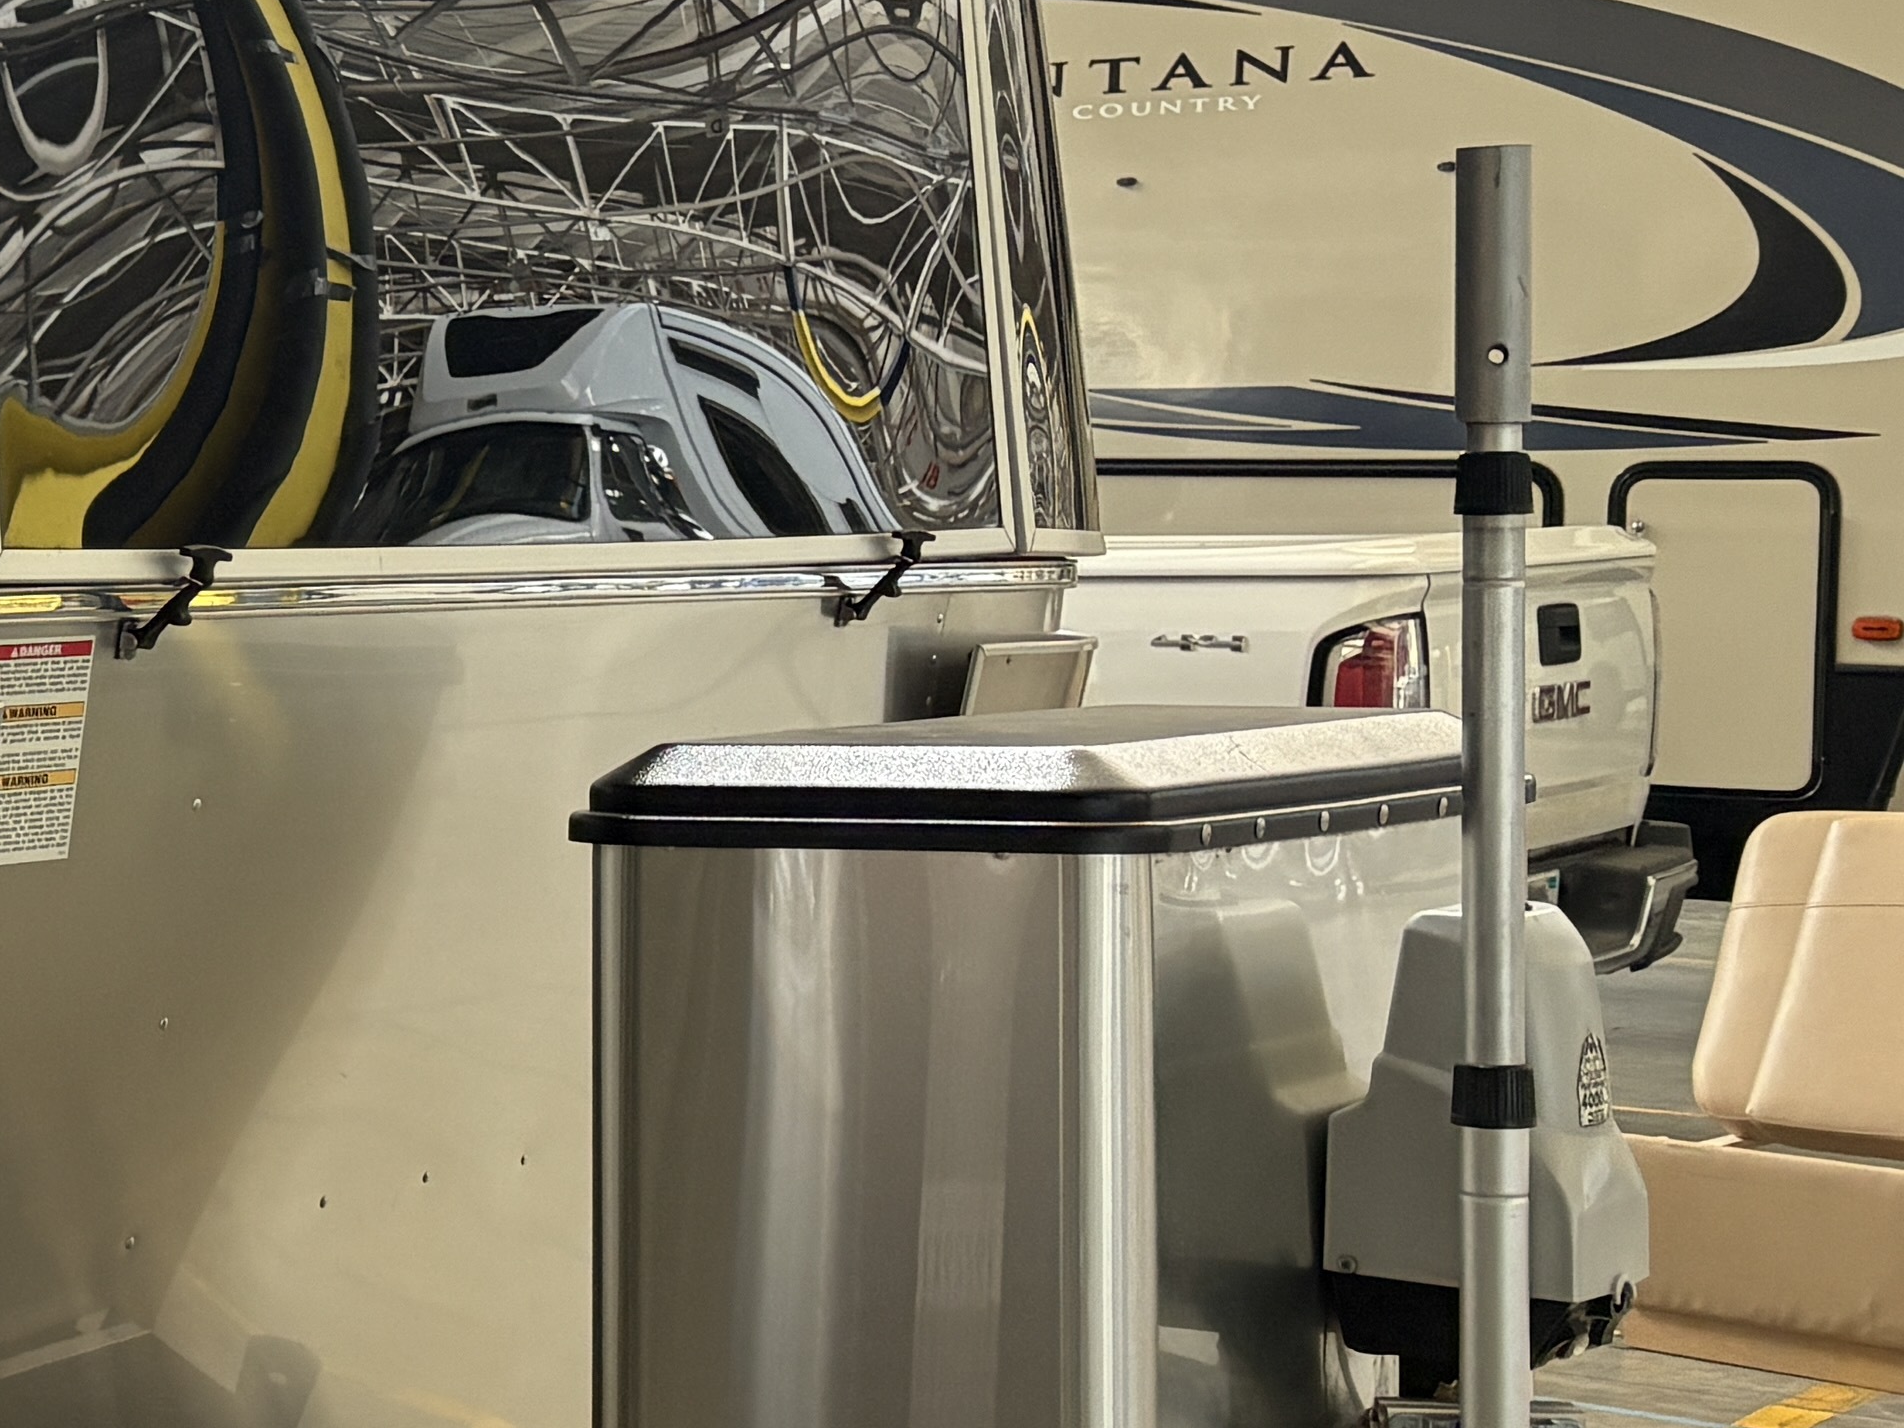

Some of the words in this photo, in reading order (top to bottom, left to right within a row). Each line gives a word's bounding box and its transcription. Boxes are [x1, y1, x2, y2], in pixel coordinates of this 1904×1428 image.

[1049, 41, 1375, 98] TANA
[1072, 94, 1262, 120] COUNTRY
[19, 644, 62, 657] DANGER
[1532, 681, 1591, 723] GMC
[9, 706, 57, 719] WARNING
[1, 774, 49, 787] WARNING
